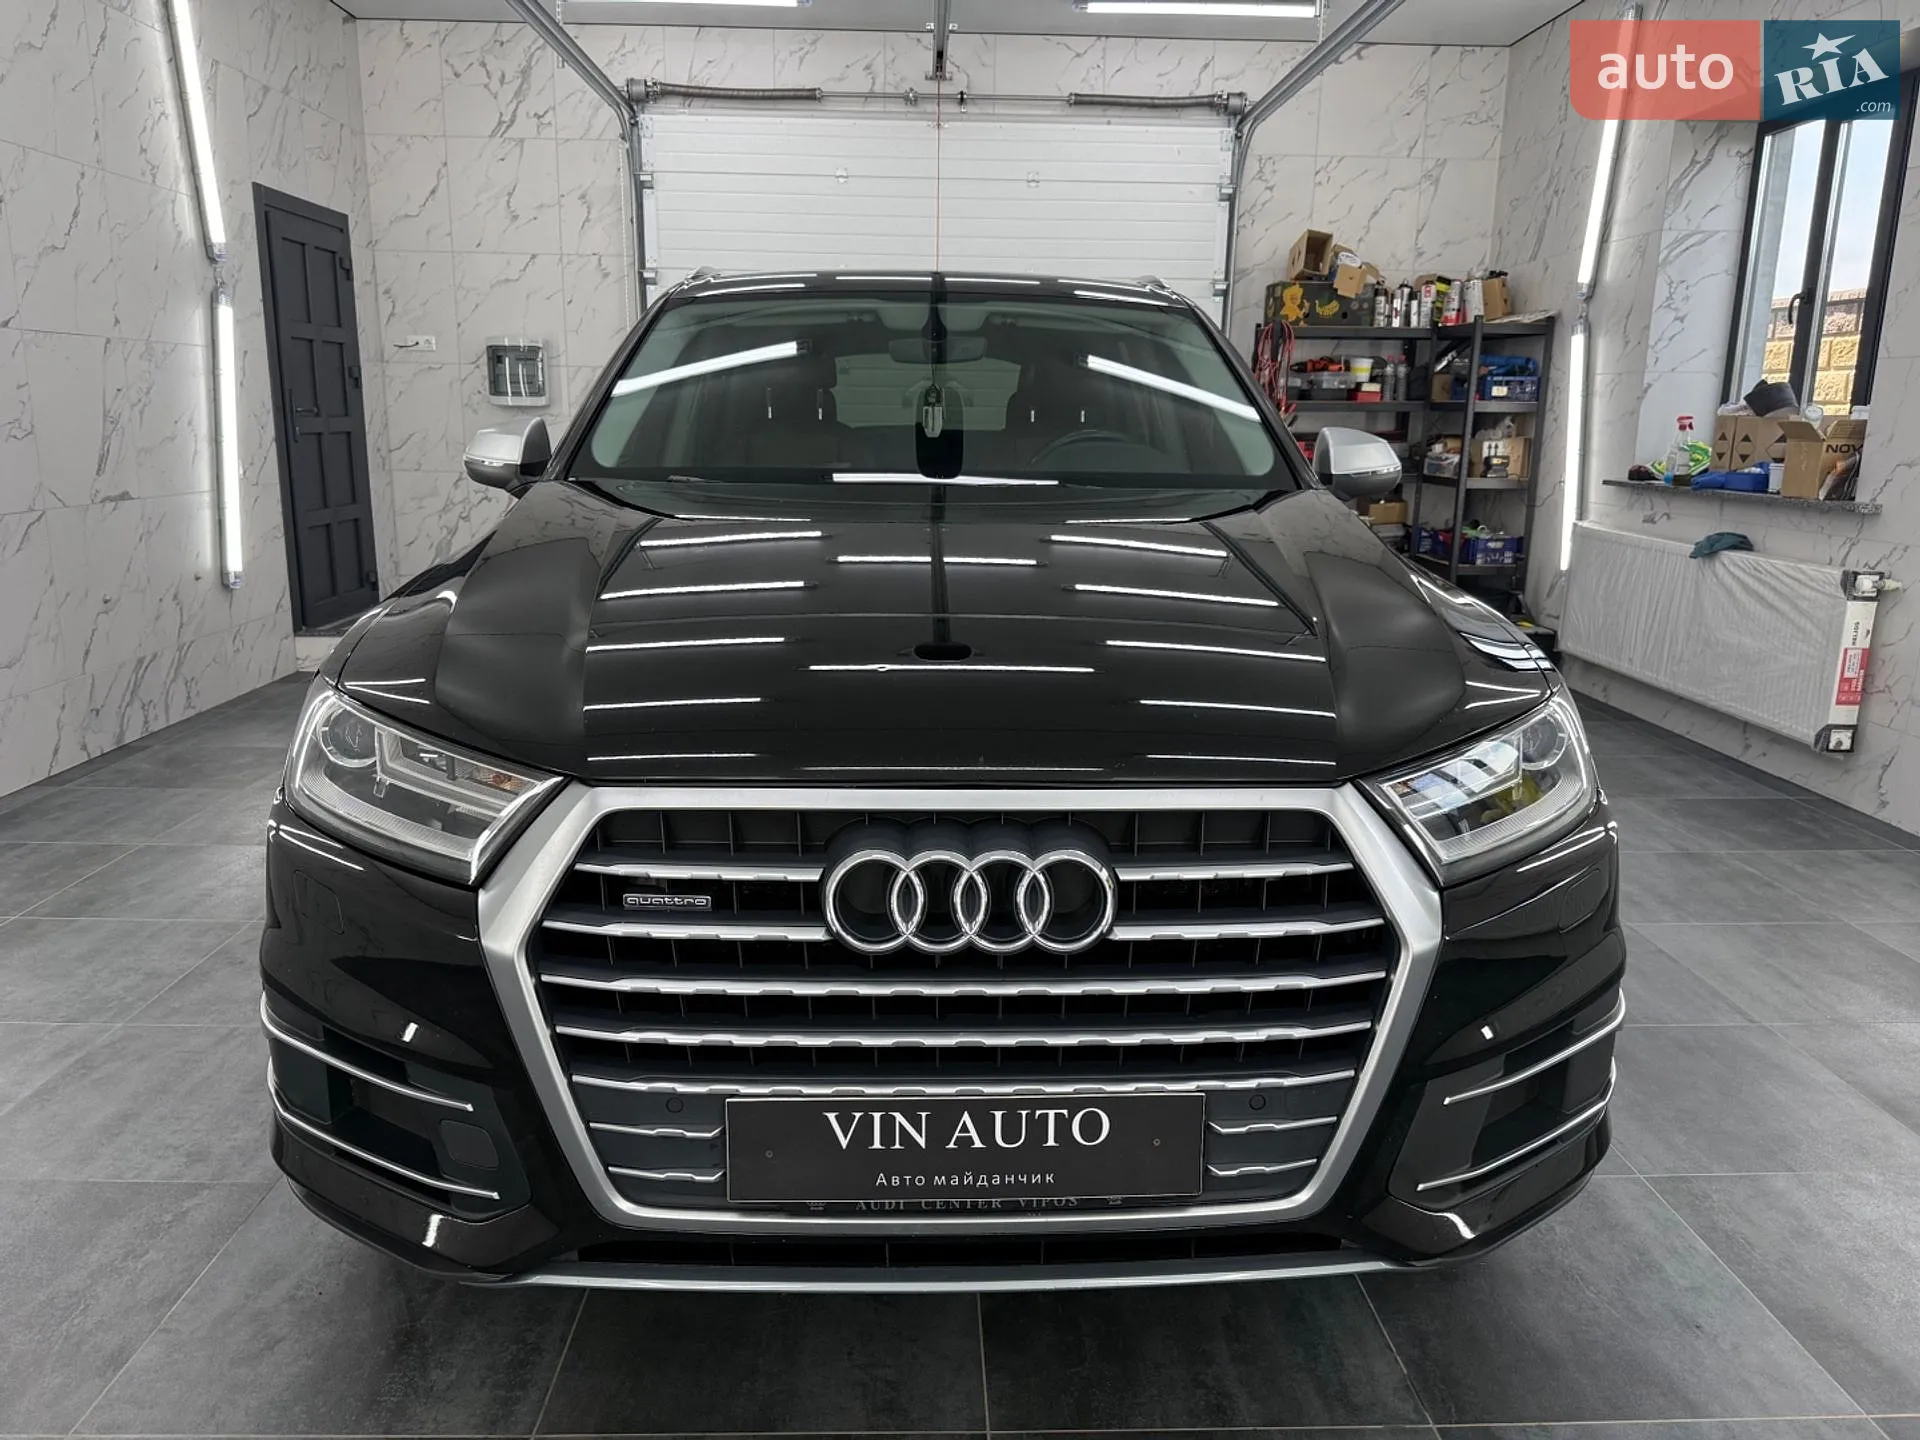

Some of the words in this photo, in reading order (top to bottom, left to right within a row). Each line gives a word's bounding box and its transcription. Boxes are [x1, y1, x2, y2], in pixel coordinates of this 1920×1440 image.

[625, 896, 708, 906] quattro
[823, 1110, 932, 1150] VIN
[945, 1107, 1111, 1149] AUTO
[876, 1172, 926, 1187] Авто
[933, 1171, 1056, 1188] майданчик
[855, 1200, 905, 1211] AUDI
[921, 1199, 1003, 1210] CENTER
